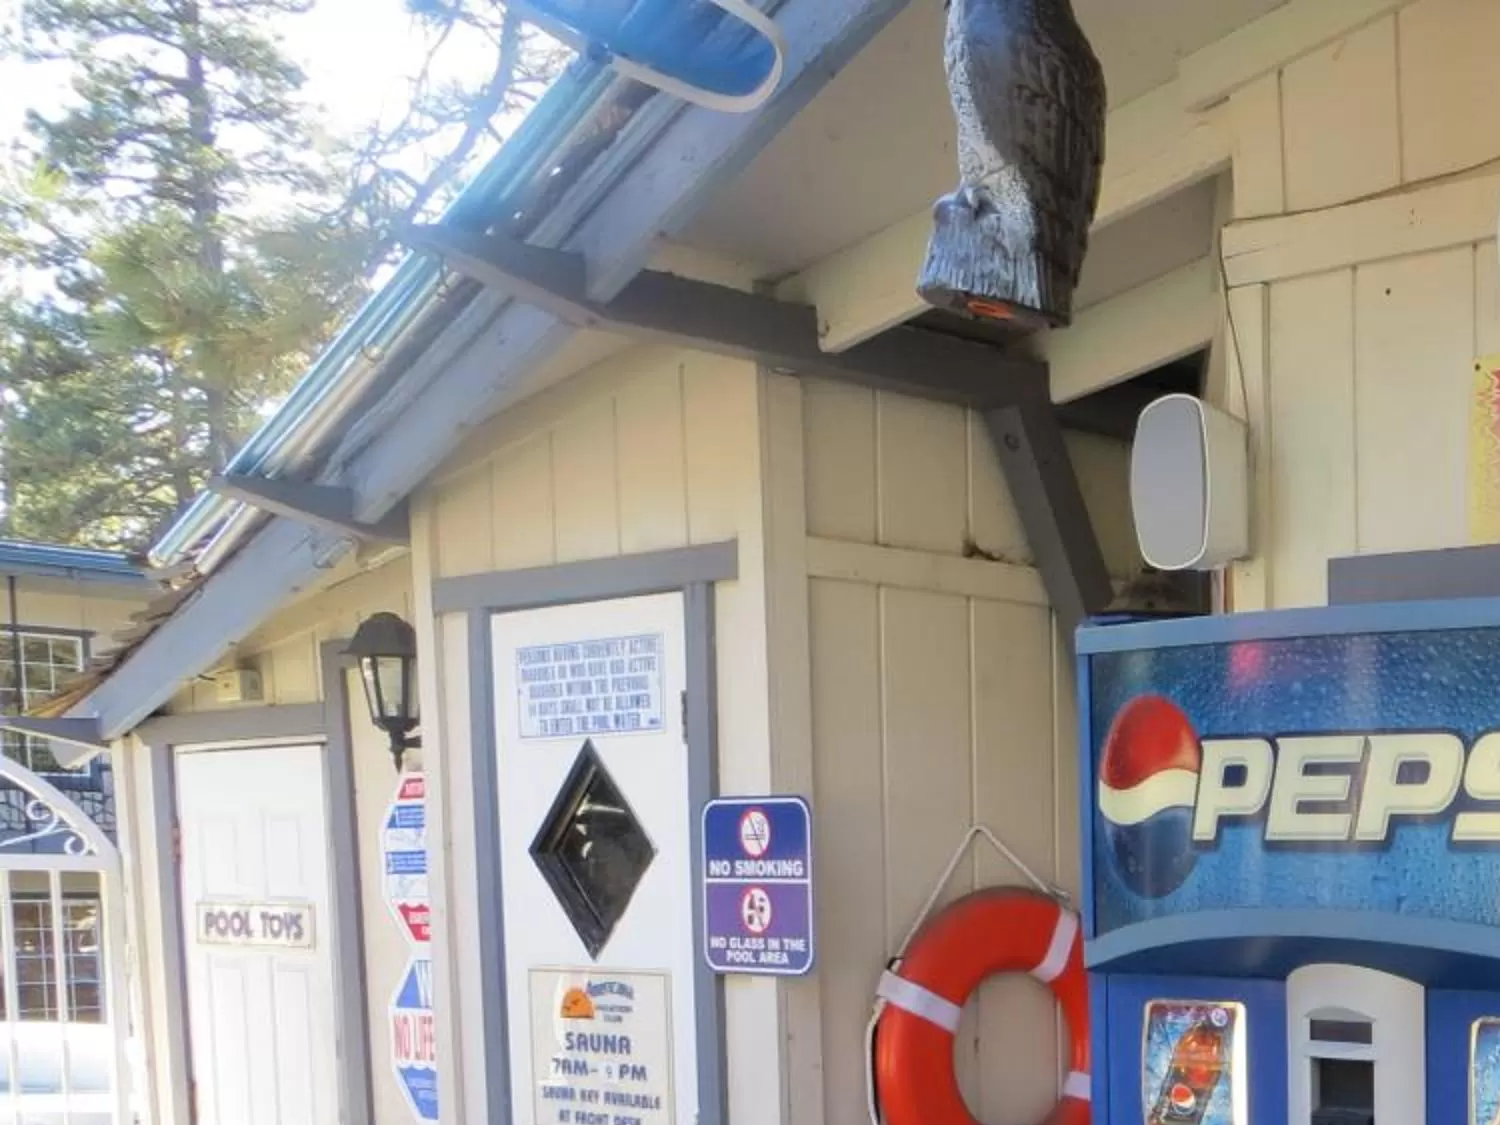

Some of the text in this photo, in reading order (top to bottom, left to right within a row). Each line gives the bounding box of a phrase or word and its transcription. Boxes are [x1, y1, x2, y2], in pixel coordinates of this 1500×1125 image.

[709, 860, 804, 877] NO SMOKING
[204, 911, 304, 940] POOL TOYS
[711, 936, 807, 951] NO GLASS IN THE
[726, 950, 789, 964] POOL AREA
[565, 1031, 631, 1055] SAUNA
[619, 1064, 647, 1081] PM
[543, 1086, 661, 1110] SAUNA KEY AVAILABLE
